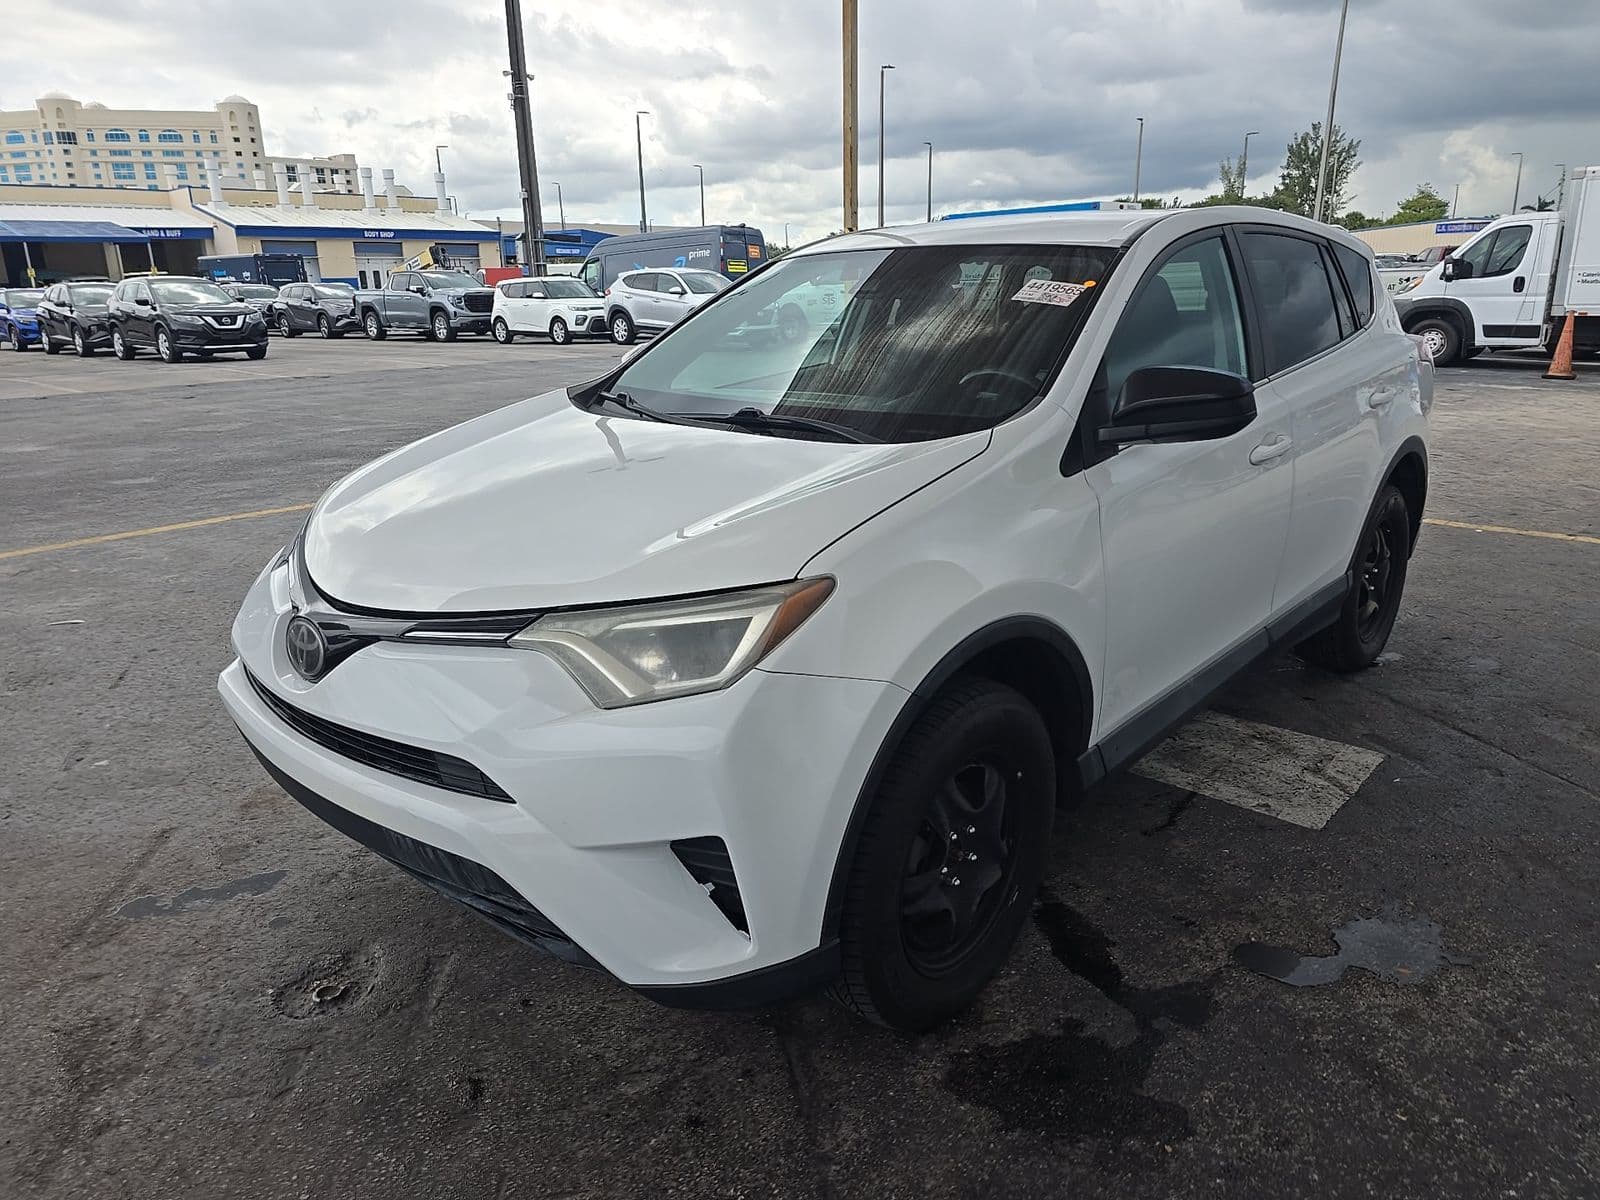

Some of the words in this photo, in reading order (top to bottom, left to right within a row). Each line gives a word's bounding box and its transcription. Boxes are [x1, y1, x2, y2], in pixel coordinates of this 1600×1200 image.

[364, 230, 379, 238] BODY
[688, 249, 710, 261] prime
[1027, 282, 1085, 296] 4419565
